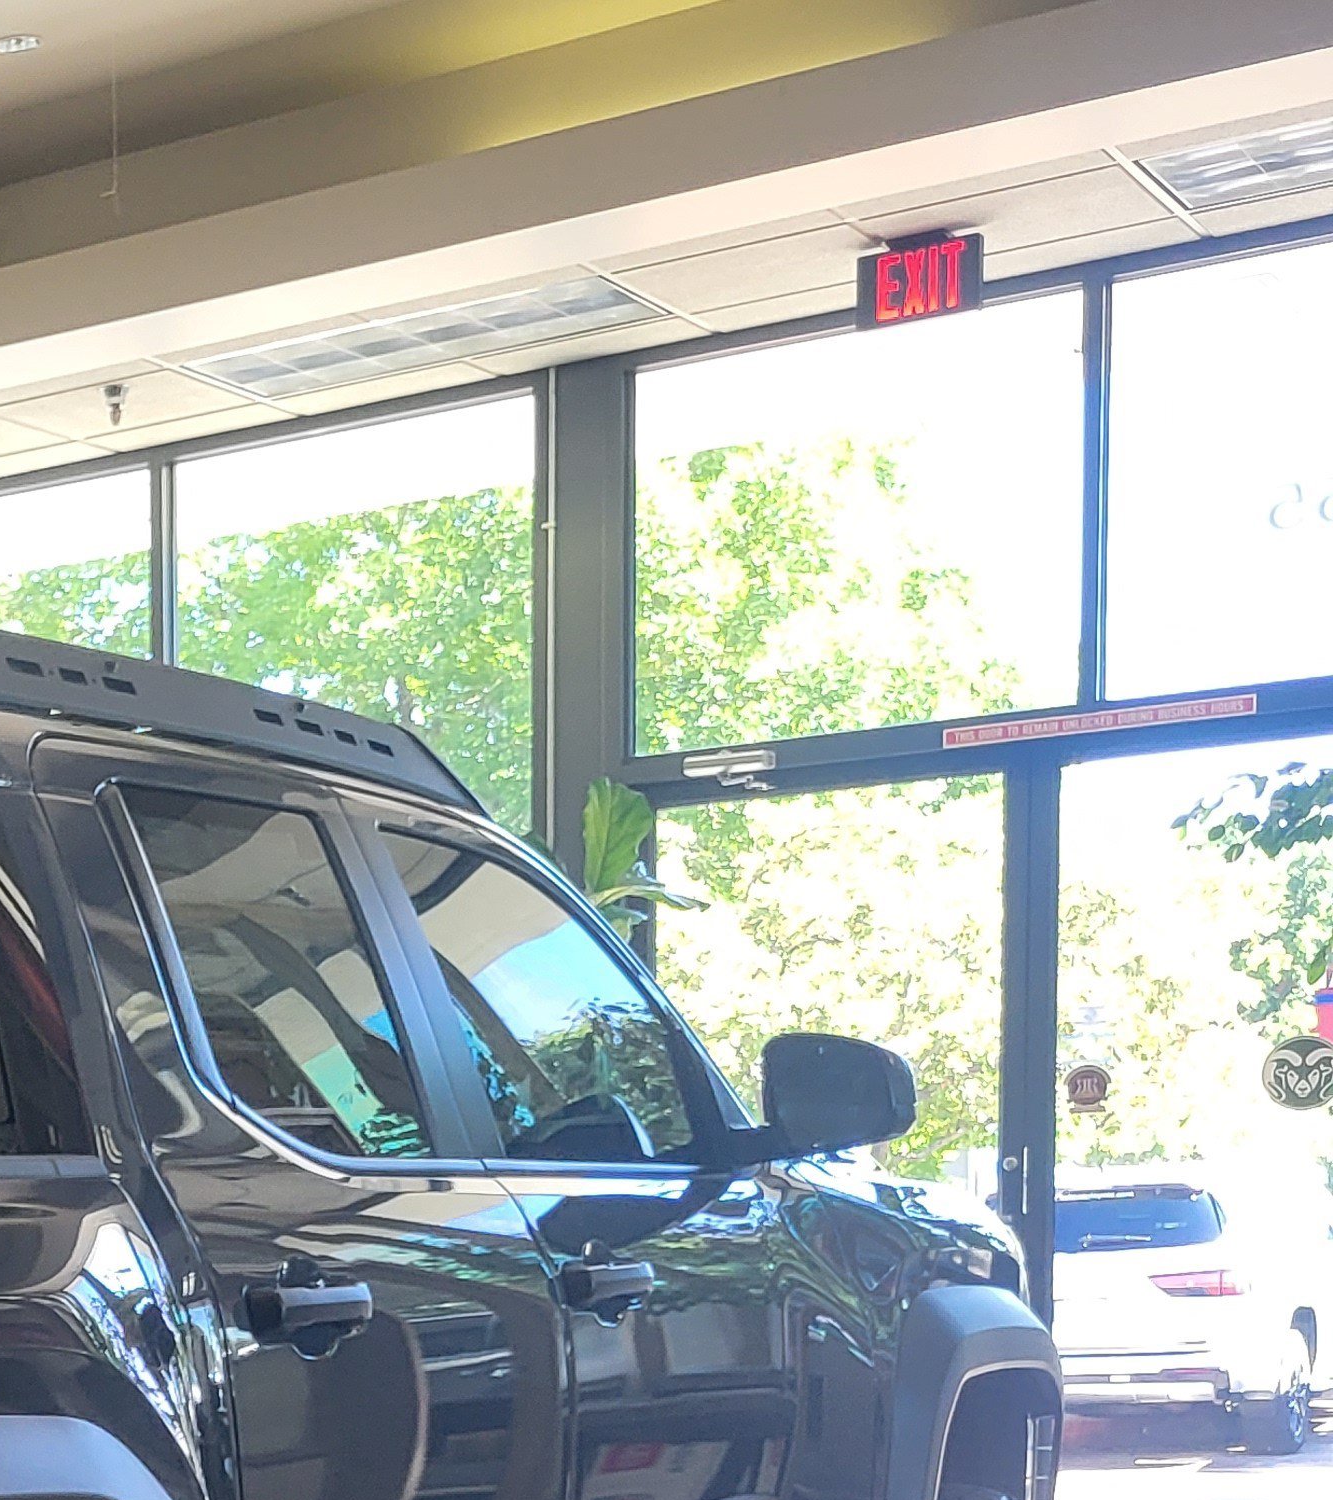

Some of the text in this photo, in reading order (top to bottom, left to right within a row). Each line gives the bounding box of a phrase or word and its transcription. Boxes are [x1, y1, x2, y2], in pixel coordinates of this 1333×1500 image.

[875, 240, 966, 323] EXIT
[955, 728, 976, 743] THIS
[1007, 724, 1020, 737] TO
[1157, 703, 1207, 720] BUSINESS
[1210, 699, 1244, 714] HOURS
